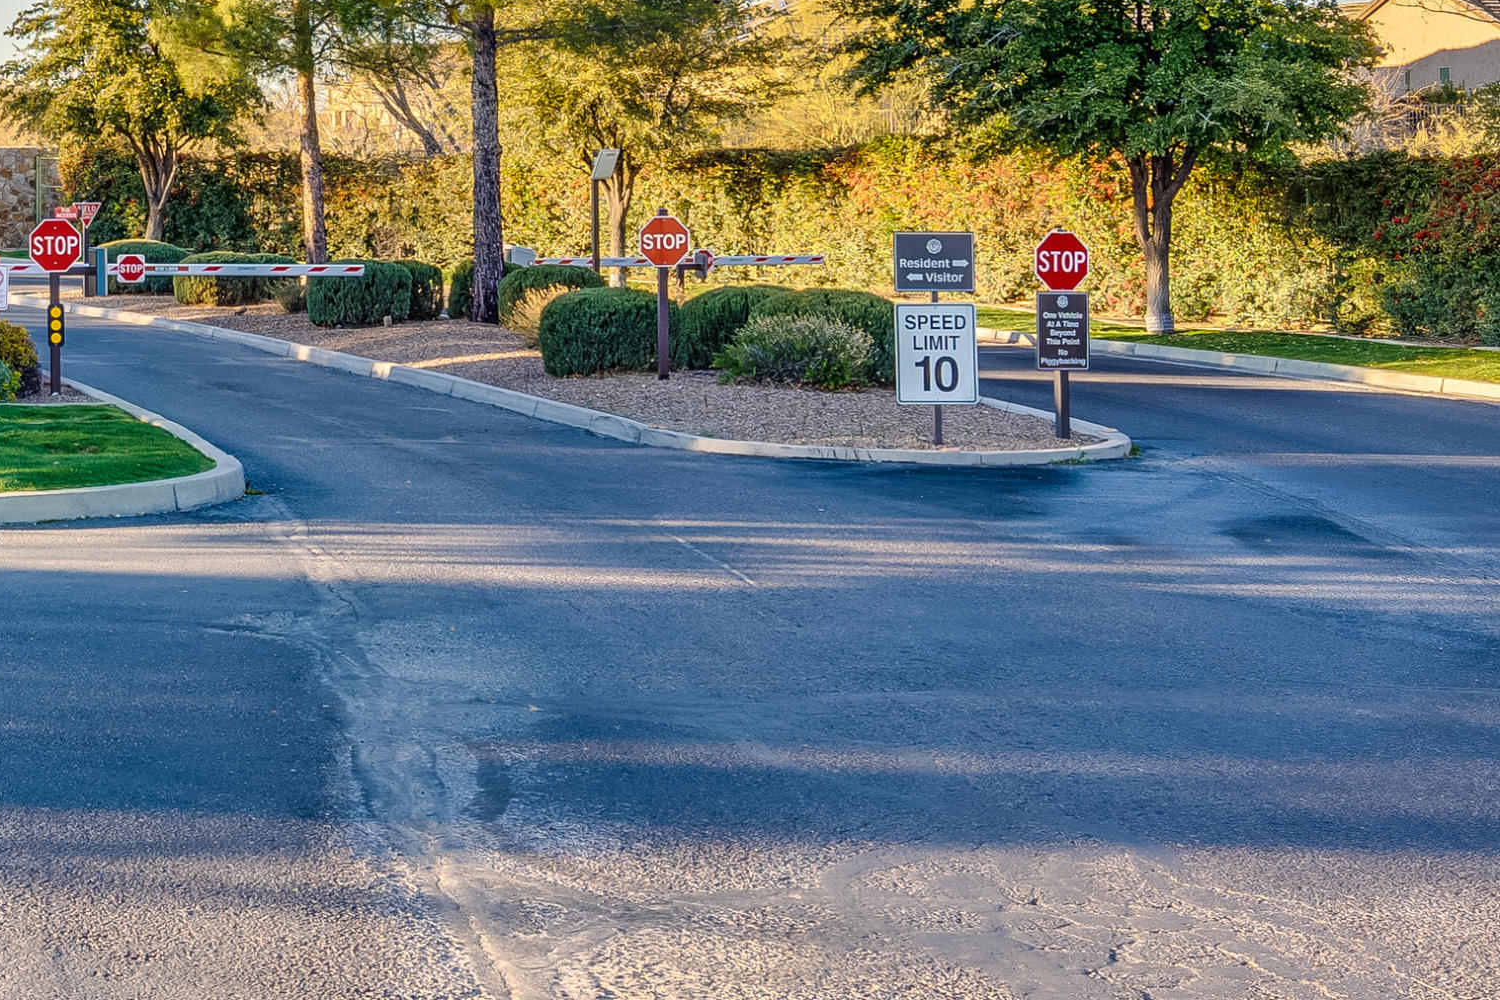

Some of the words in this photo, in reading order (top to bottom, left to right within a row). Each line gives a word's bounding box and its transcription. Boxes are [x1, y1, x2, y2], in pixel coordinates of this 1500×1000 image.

[32, 236, 78, 256] STOP
[643, 233, 686, 250] STOP
[120, 263, 143, 274] STOP
[899, 258, 951, 268] Resident
[1038, 251, 1086, 272] STOP
[925, 272, 964, 282] Visitor
[905, 314, 966, 330] SPEED
[1050, 329, 1076, 337] Beyond
[913, 335, 960, 350] LIMIT
[1040, 357, 1086, 366] Piggybacking
[915, 356, 958, 392] 10
